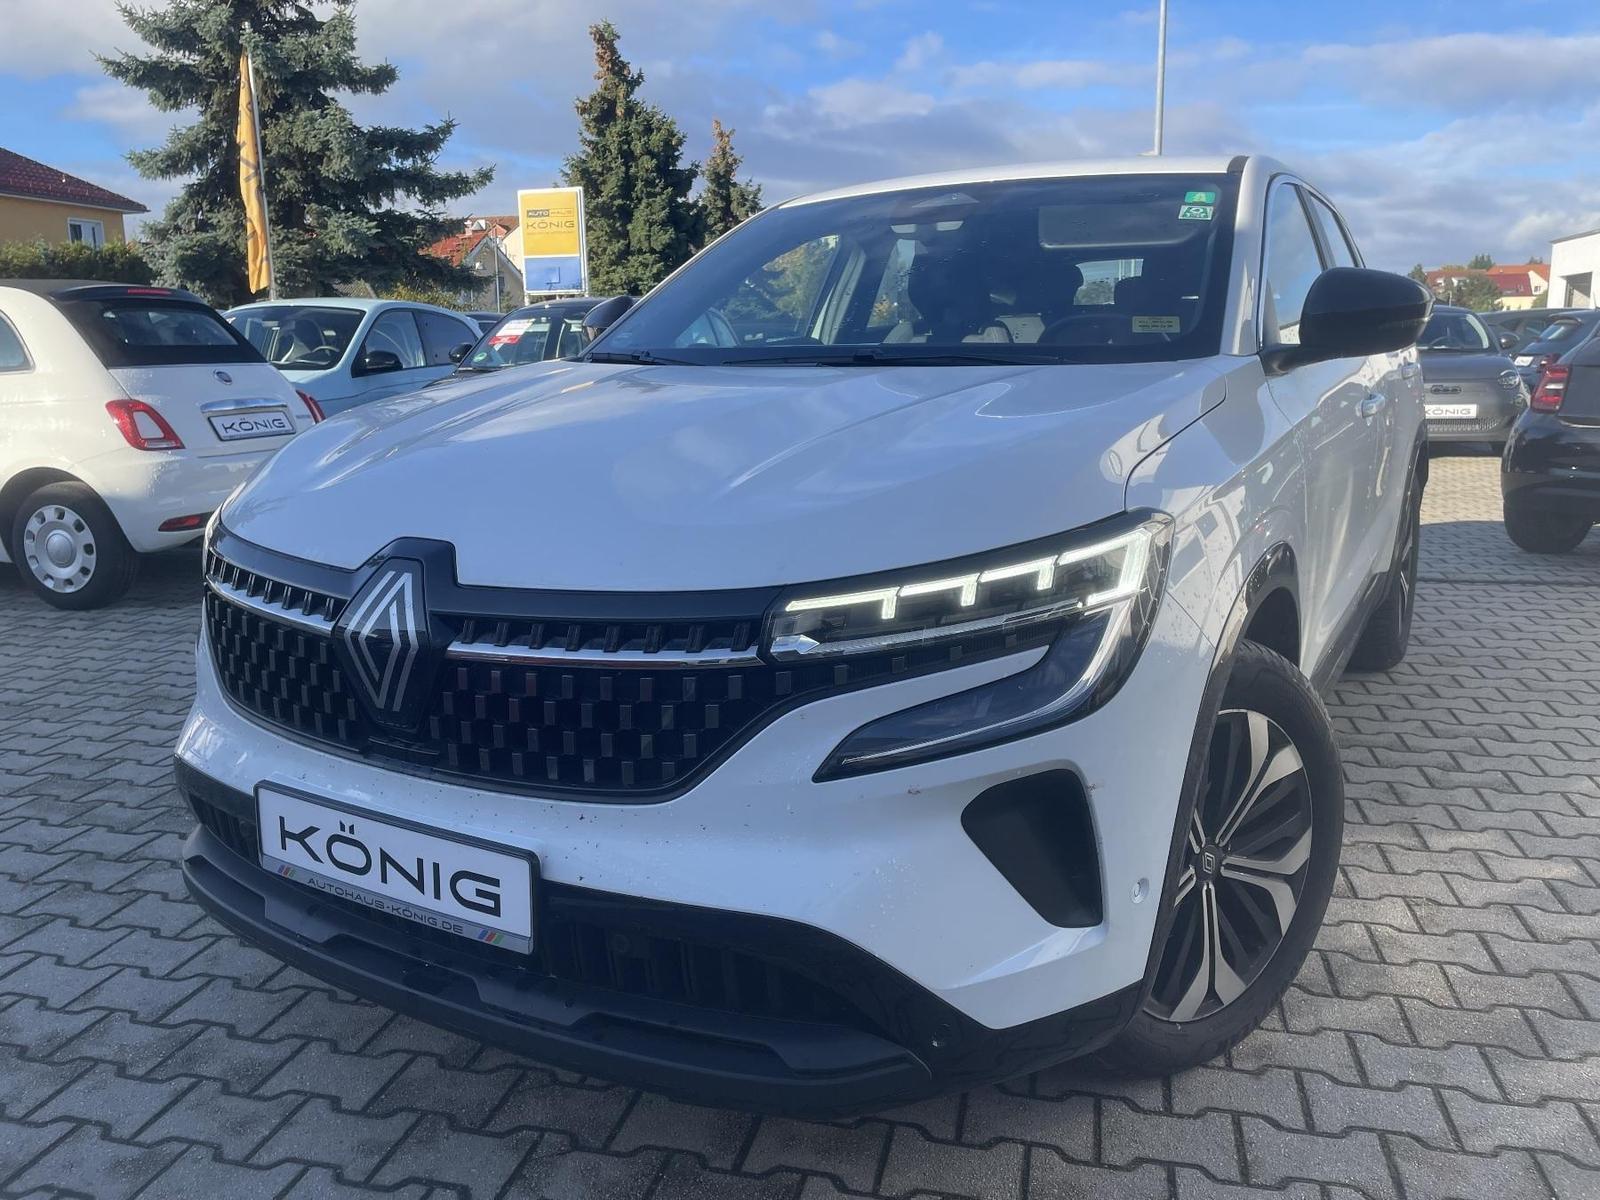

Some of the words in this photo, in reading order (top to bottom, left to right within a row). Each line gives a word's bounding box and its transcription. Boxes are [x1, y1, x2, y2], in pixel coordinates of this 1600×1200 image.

[526, 219, 575, 229] KÖNIG
[221, 417, 286, 433] KÖNIG
[278, 815, 501, 917] KÖNIG
